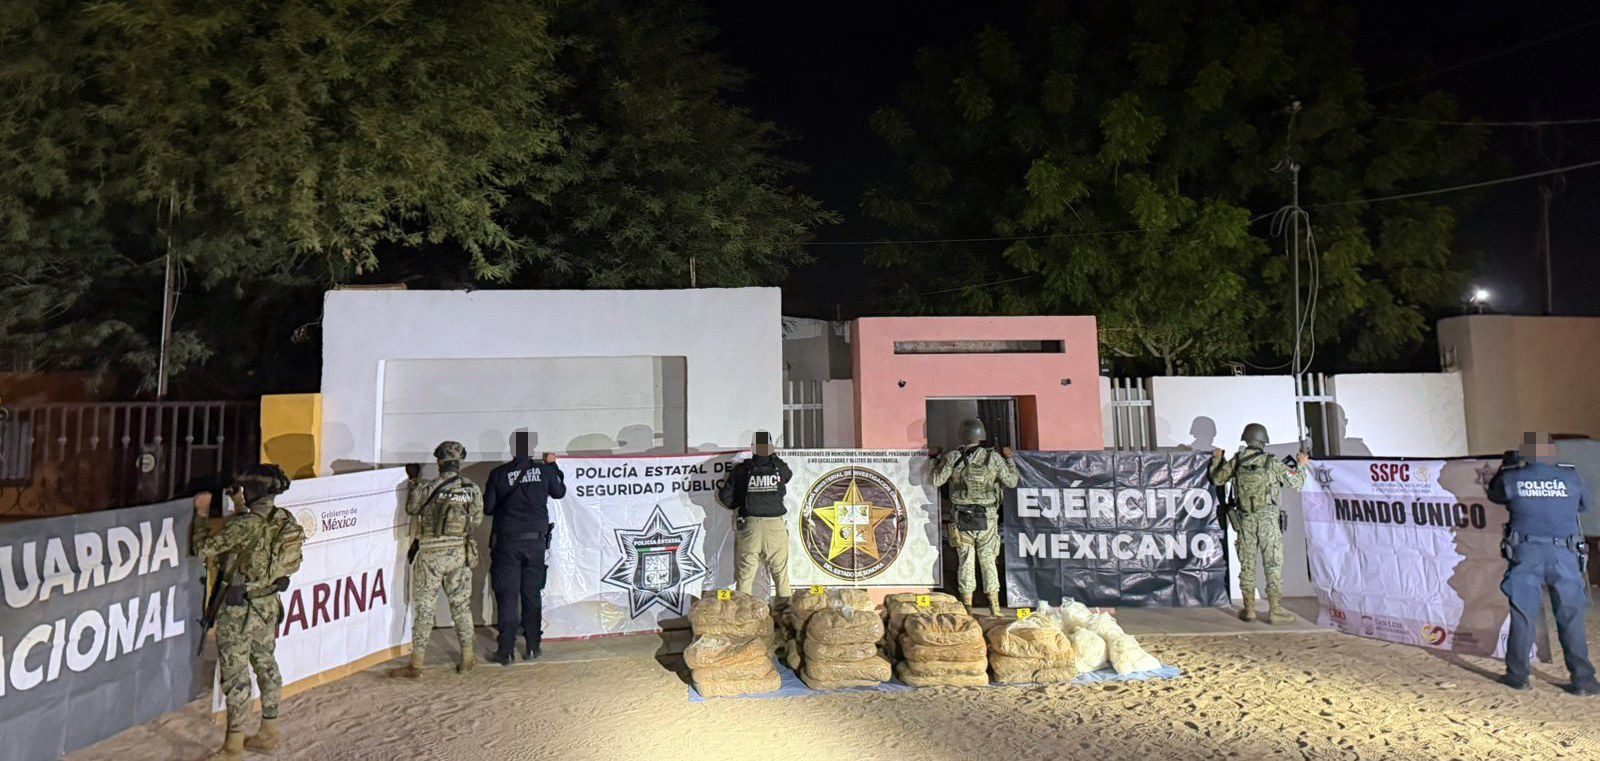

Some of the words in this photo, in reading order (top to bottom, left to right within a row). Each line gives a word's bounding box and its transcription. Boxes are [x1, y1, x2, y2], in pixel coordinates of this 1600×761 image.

[576, 463, 638, 479] POLICÍA
[644, 464, 707, 477] ESTATAL
[714, 462, 732, 473] DE
[1370, 463, 1410, 482] SSPC
[576, 482, 664, 497] SEGURIDAD
[672, 478, 726, 493] PÚBLIC
[1516, 479, 1567, 490] POLICÍA
[1017, 480, 1213, 518] EJÉRCITO
[322, 510, 350, 518] Gobierno
[350, 506, 358, 514] de
[322, 515, 357, 532] México
[1334, 498, 1406, 524] MANDO
[1412, 498, 1486, 529] ÚNICO
[1018, 533, 1215, 560] MEXICANO
[0, 517, 179, 608] UARDIA
[275, 568, 387, 638] ARINA
[0, 585, 185, 697] CIONAL
